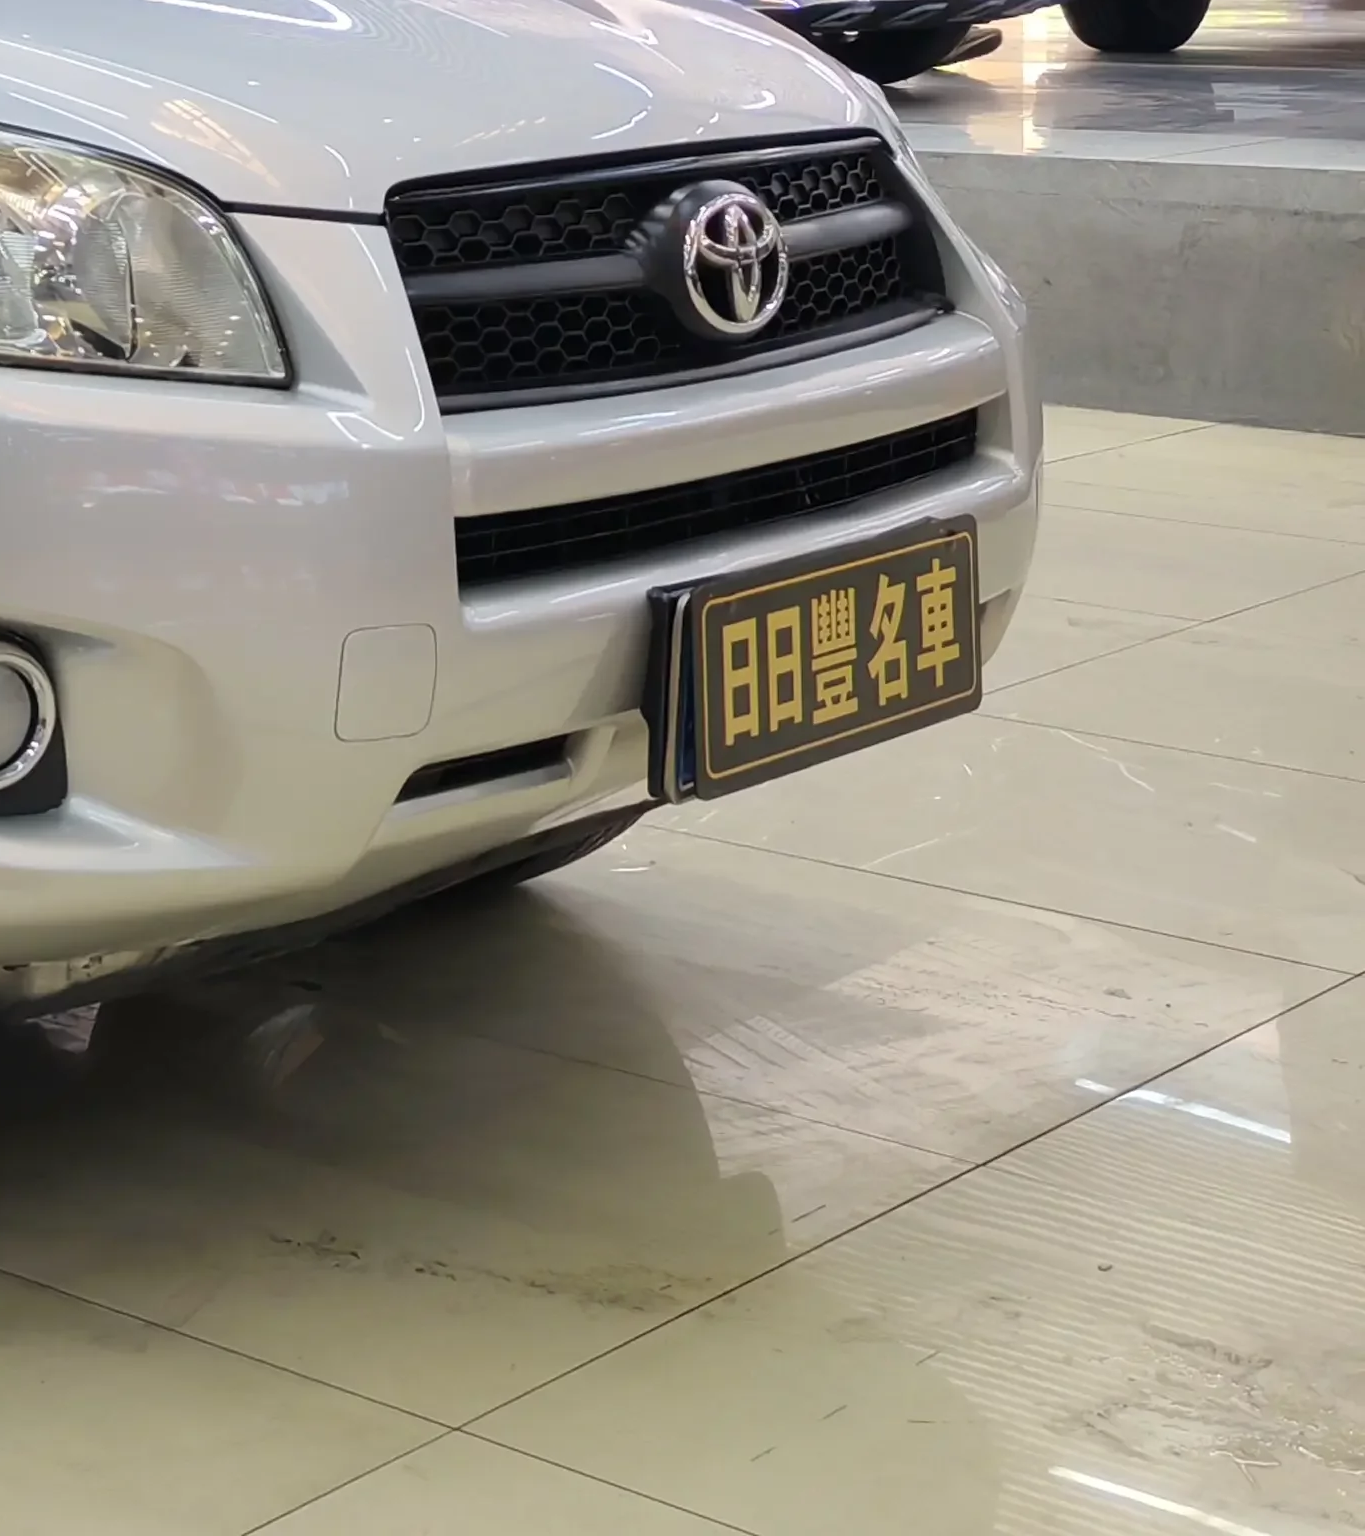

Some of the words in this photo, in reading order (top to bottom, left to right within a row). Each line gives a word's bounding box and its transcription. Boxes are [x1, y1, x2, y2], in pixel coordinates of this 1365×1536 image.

[722, 558, 960, 746] 日日豐名車
